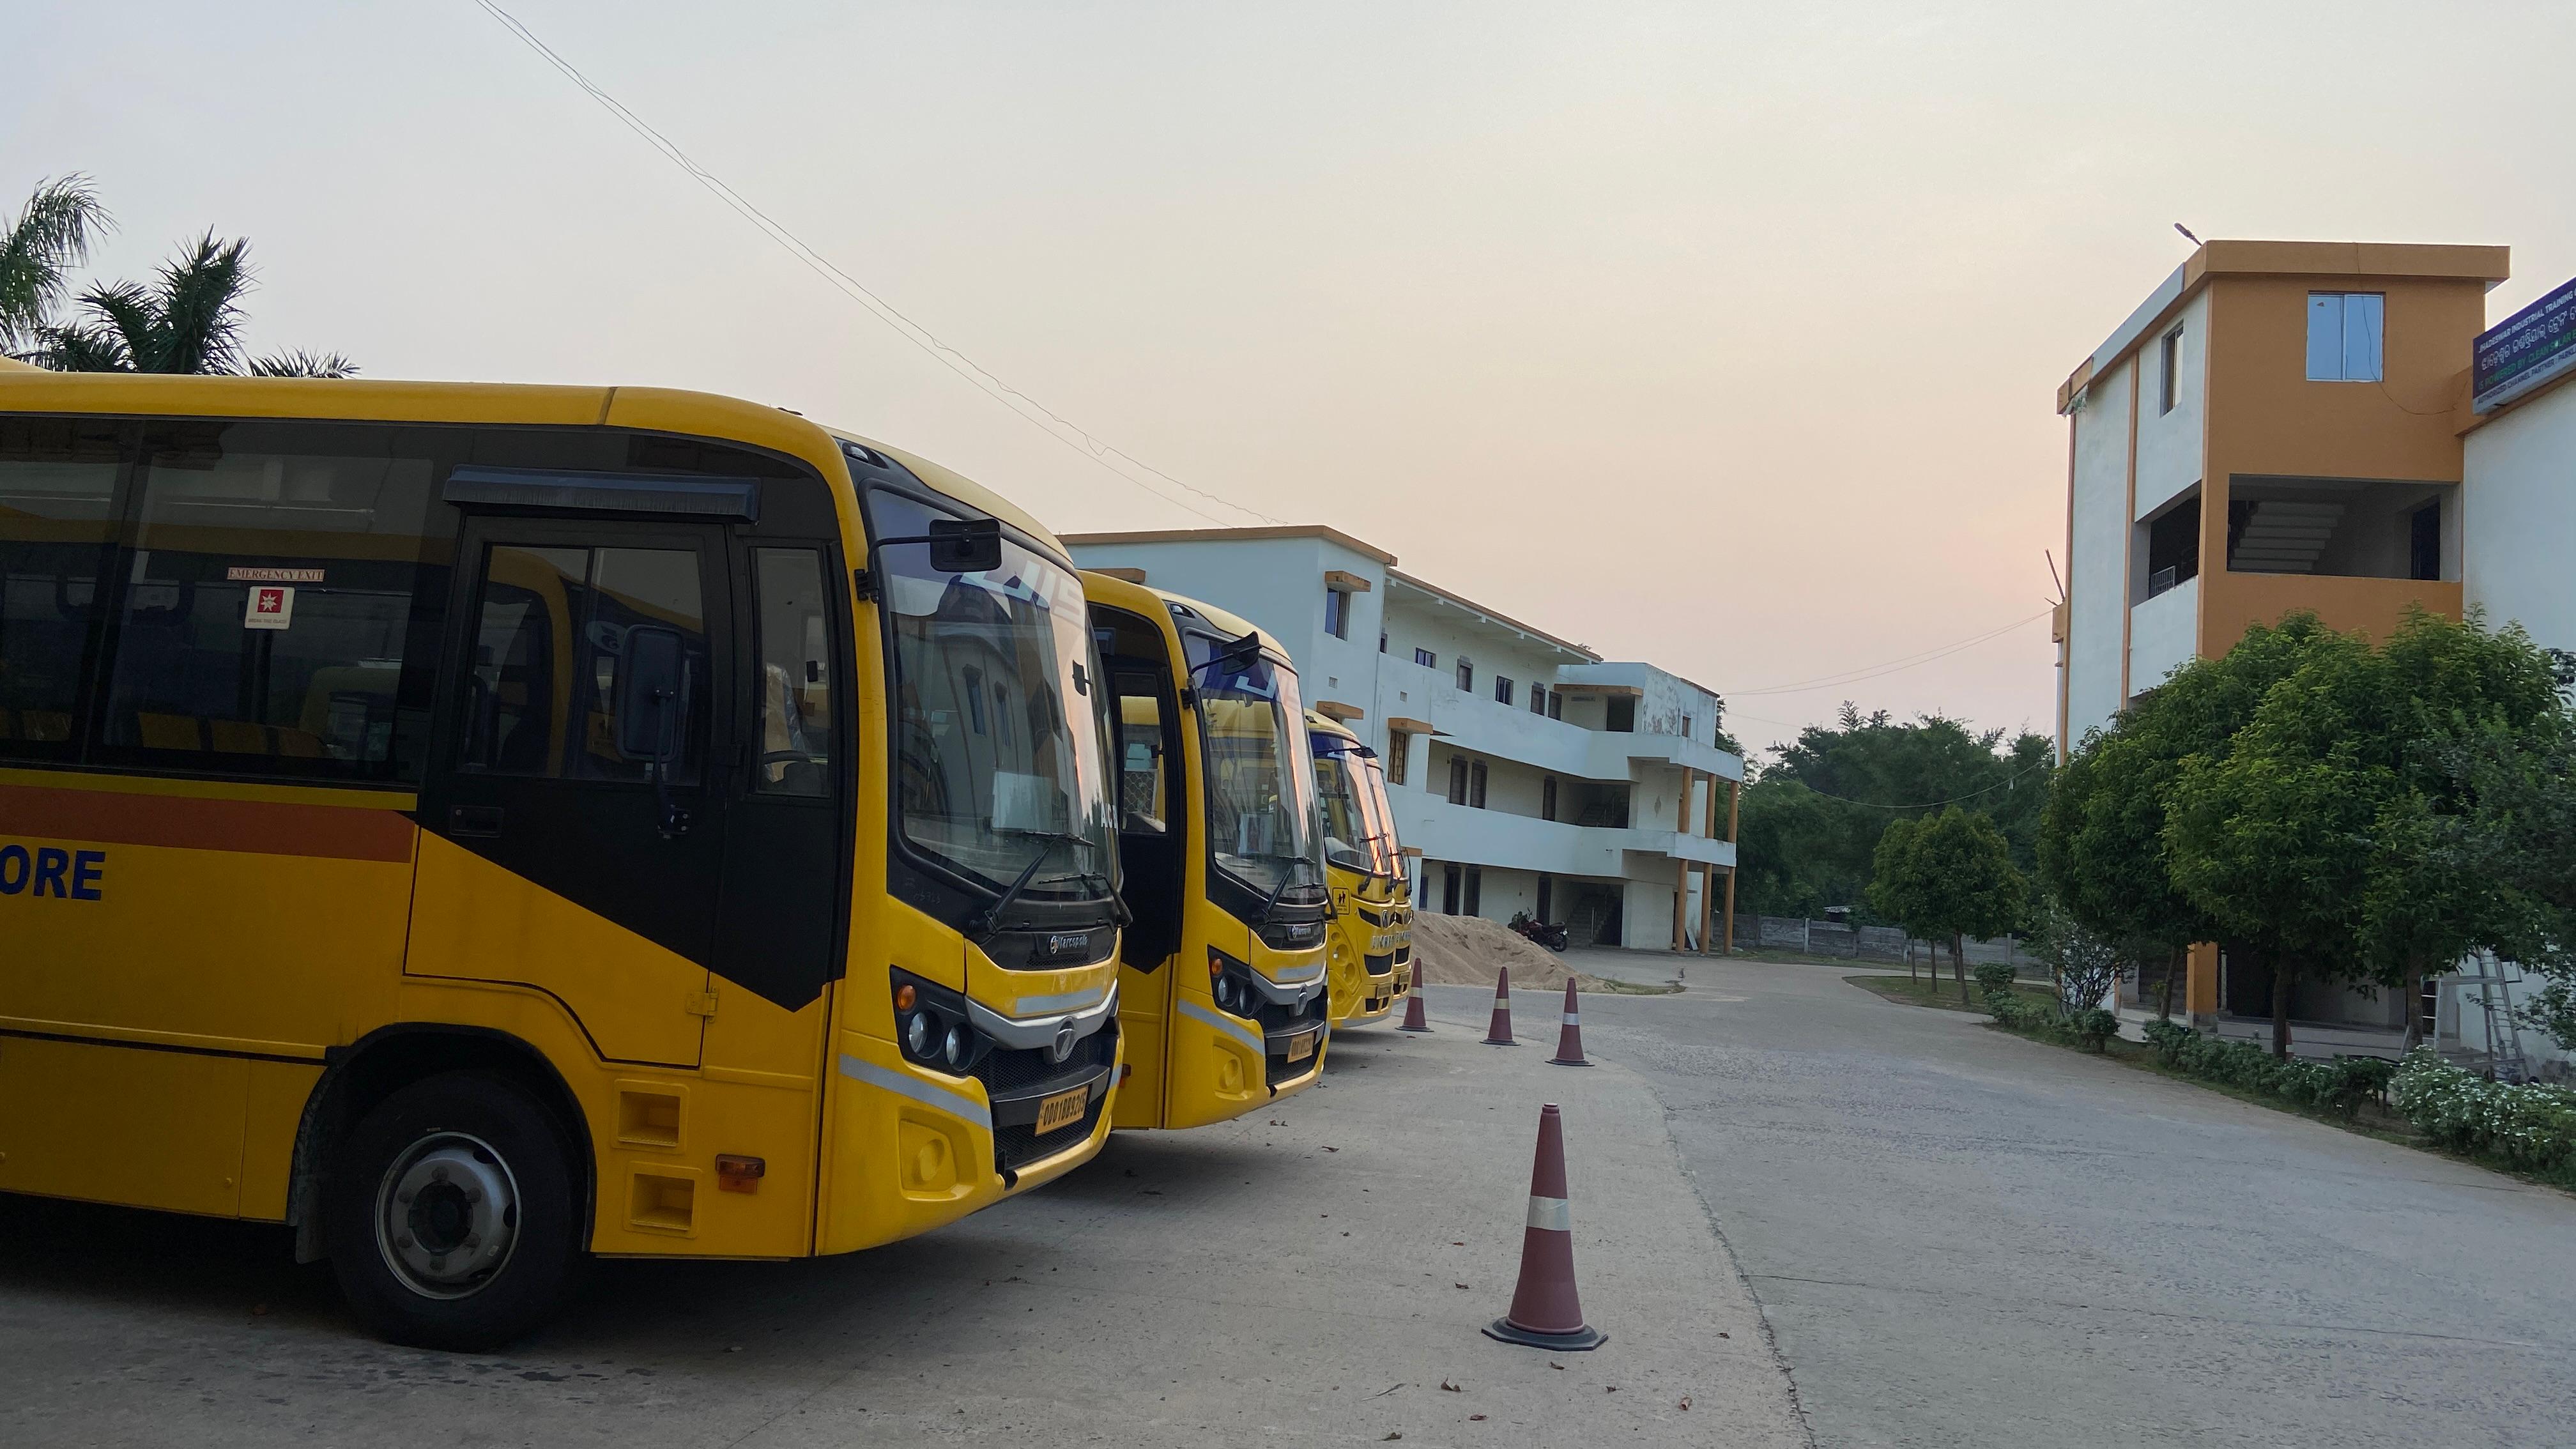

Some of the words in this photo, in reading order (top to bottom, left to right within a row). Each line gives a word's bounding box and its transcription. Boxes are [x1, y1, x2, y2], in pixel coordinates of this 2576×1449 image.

[2511, 309, 2545, 334] INDUSTRIAL
[2545, 290, 2573, 314] TRAINING
[2517, 356, 2526, 370] BY
[2528, 346, 2550, 364] CLEAN
[229, 569, 293, 581] EMERGENCY
[298, 571, 323, 581] EXIT
[0, 844, 106, 901] ORE
